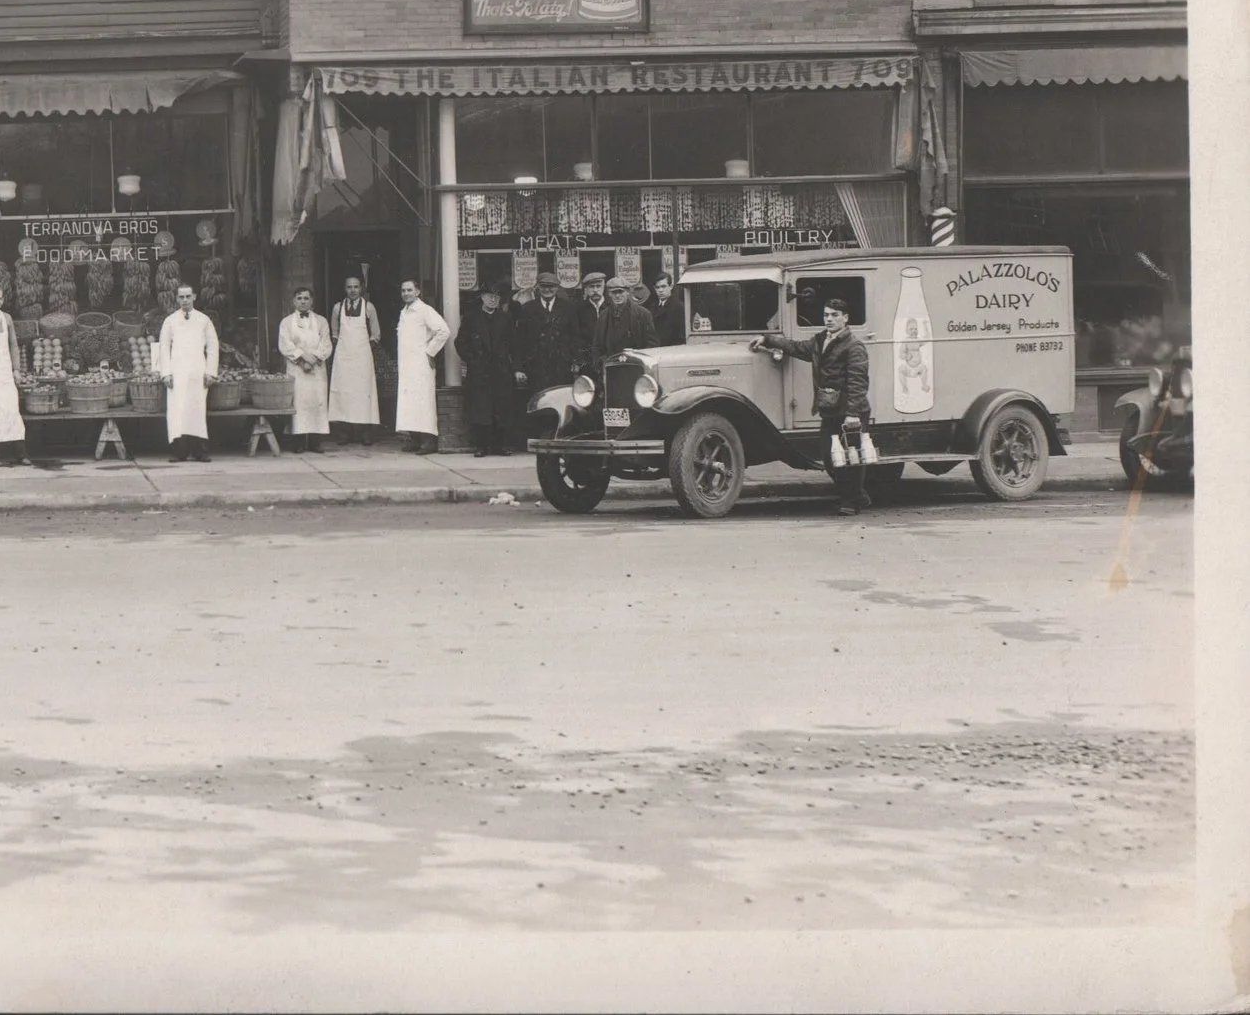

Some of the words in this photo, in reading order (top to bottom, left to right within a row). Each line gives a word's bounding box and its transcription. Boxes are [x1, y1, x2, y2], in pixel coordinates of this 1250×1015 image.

[326, 69, 379, 89] 709
[393, 69, 454, 89] THE
[473, 66, 609, 88] ITALIAN
[631, 61, 834, 85] RESTAURANT
[852, 59, 913, 81] 709
[23, 220, 113, 236] TERRANOVA
[119, 219, 158, 235] BROS
[520, 235, 587, 250] MEATS
[744, 229, 833, 245] POULTRY
[23, 249, 73, 263] FOOD
[79, 246, 162, 262] MARKET
[513, 249, 537, 258] KRAFT
[556, 249, 580, 258] KRAFT
[616, 246, 640, 255] KRAFT
[717, 244, 741, 253] KRAFT
[946, 263, 1060, 297] PALAZZOLO'S
[975, 293, 1035, 310] DAIRY
[947, 320, 977, 333] Golden
[980, 319, 1011, 334] Jersey
[1018, 318, 1060, 330] Products
[1016, 342, 1037, 353] PHONE
